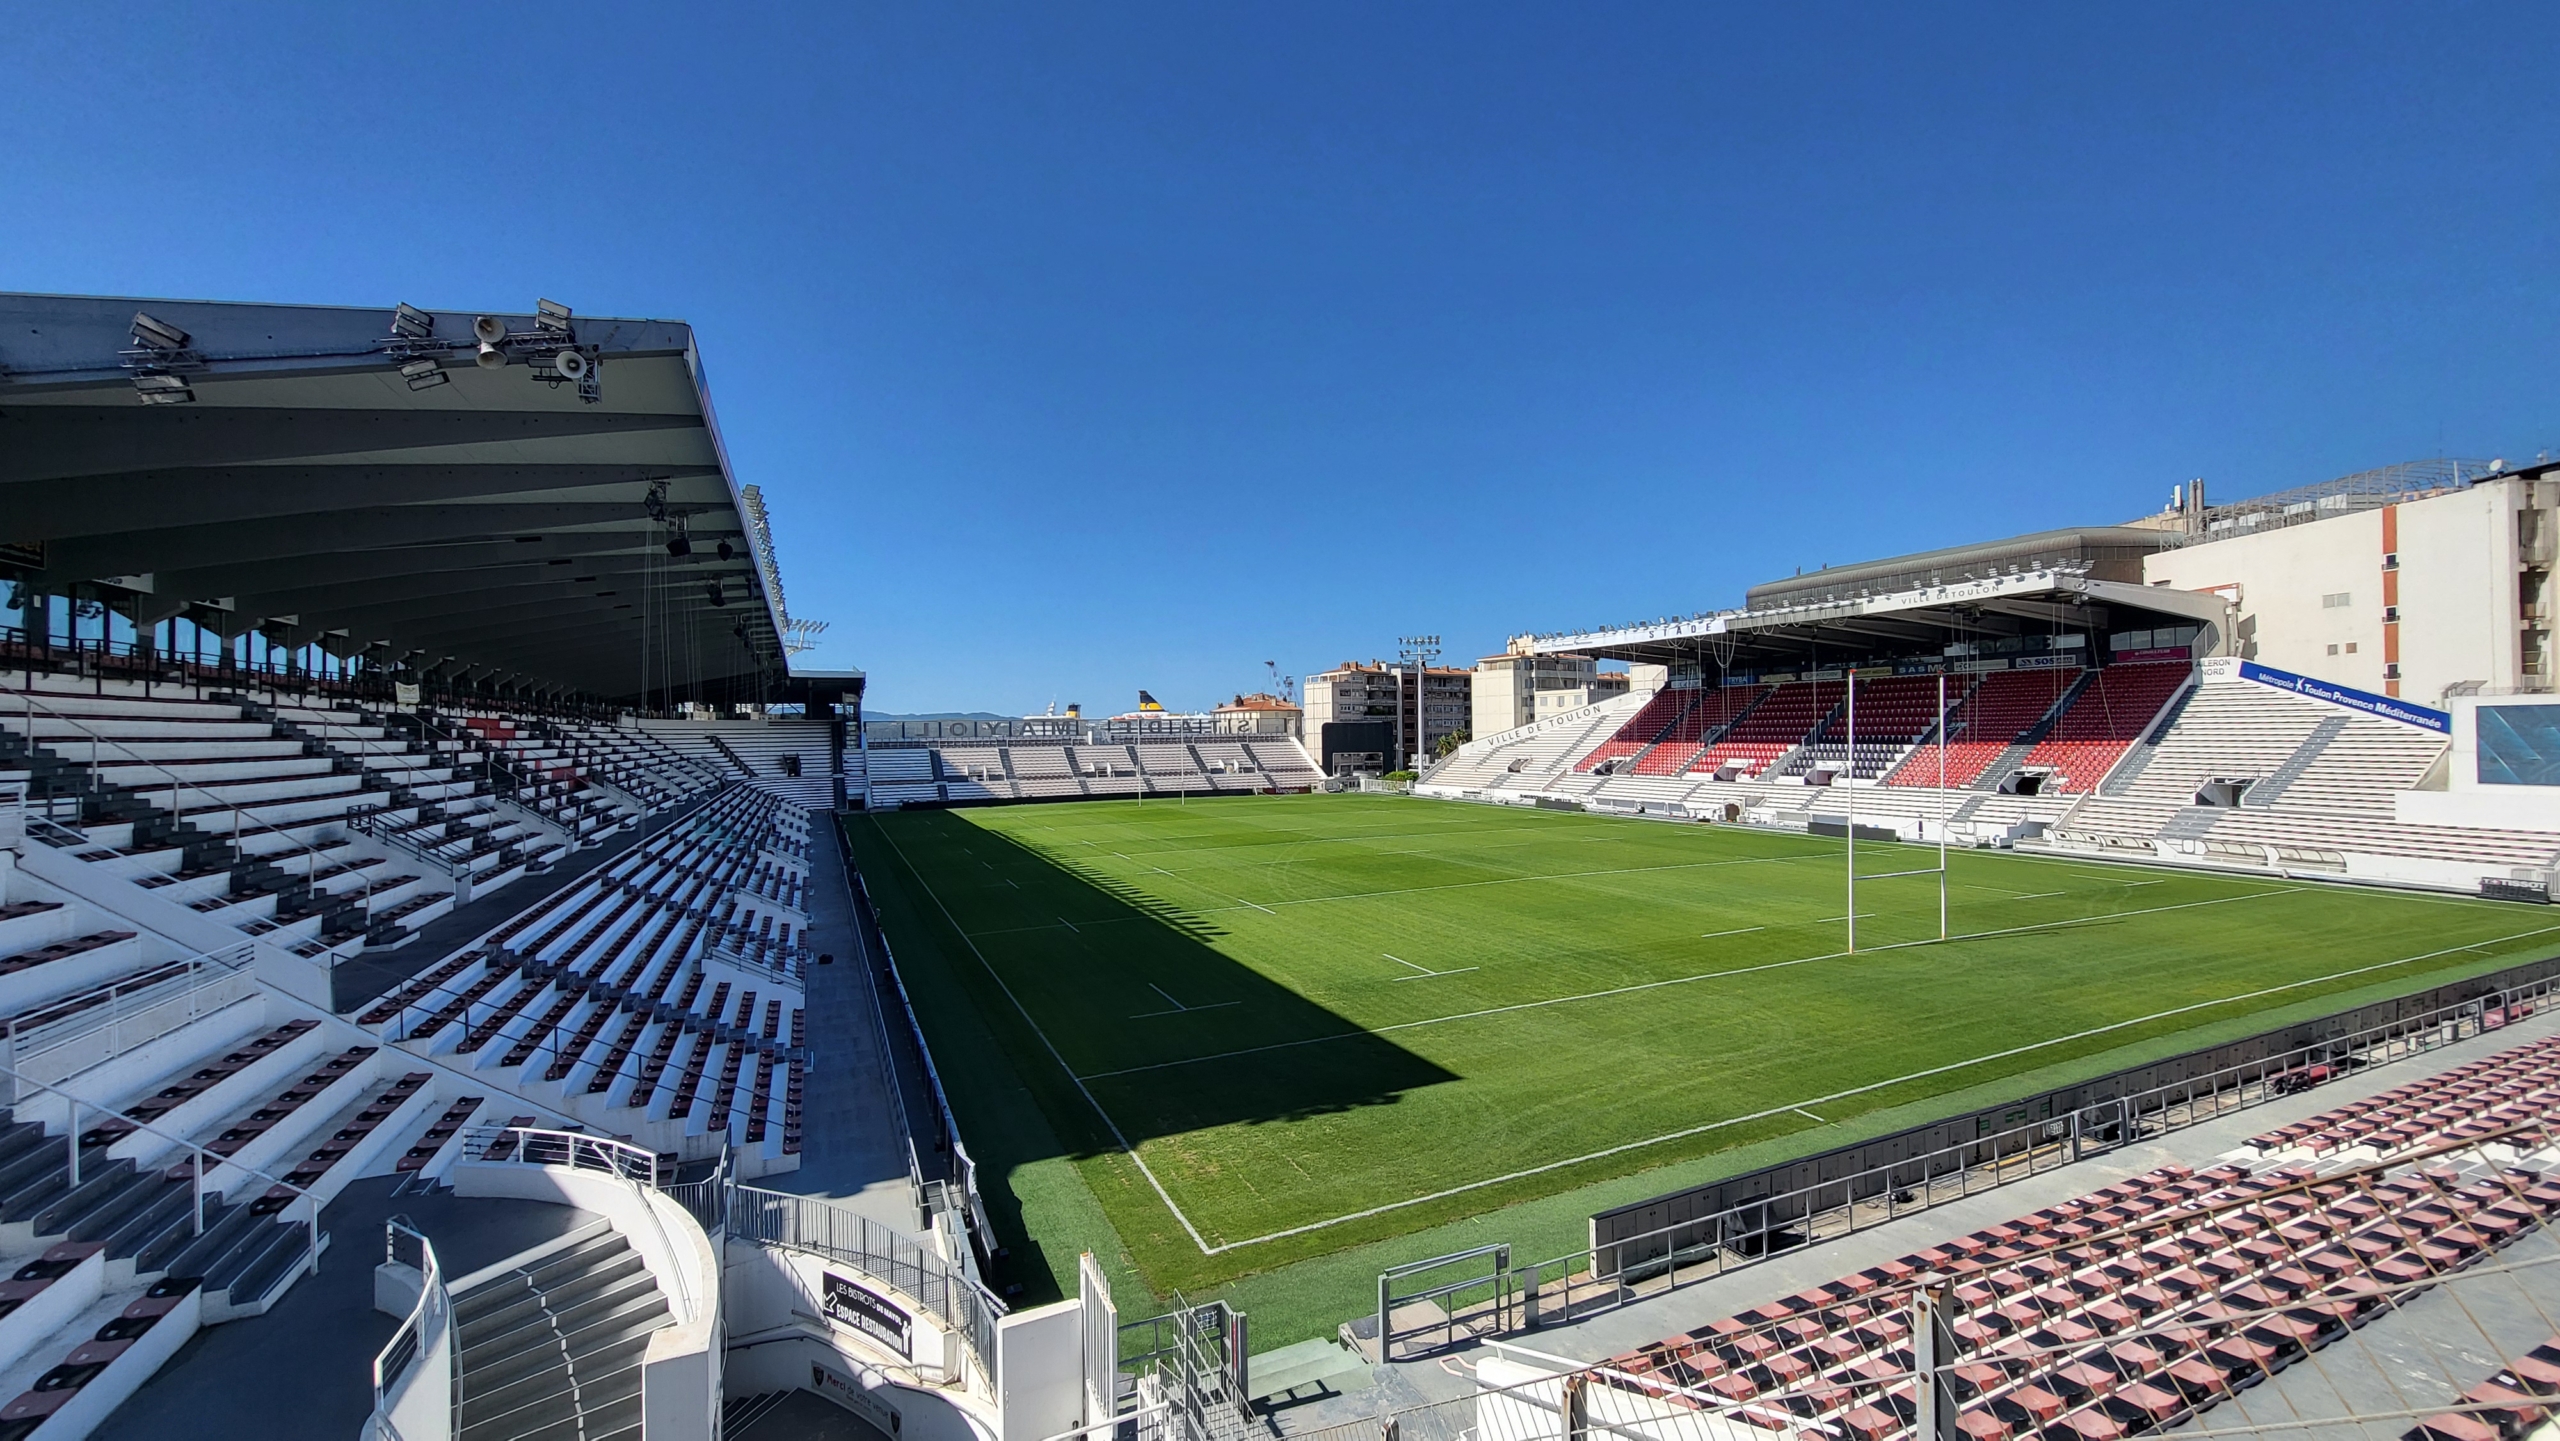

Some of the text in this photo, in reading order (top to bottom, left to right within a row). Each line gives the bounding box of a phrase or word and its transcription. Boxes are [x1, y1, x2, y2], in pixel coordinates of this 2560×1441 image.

[1901, 595, 1930, 605] VILLE
[1648, 622, 1712, 639] STADE
[1899, 663, 1947, 674] SAS MK
[2034, 658, 2054, 666] SOS
[2258, 672, 2442, 729] Métropole Toulon Provence Méditerranée
[1487, 705, 1601, 746] VILLE DE TOULON
[2501, 880, 2547, 889] TISSOT
[836, 1282, 903, 1326] LES BISTROTS DE MAYOL
[836, 1303, 903, 1352] ESPACE RESTAURATION
[826, 1373, 846, 1392] Merci
[847, 1385, 855, 1395] de
